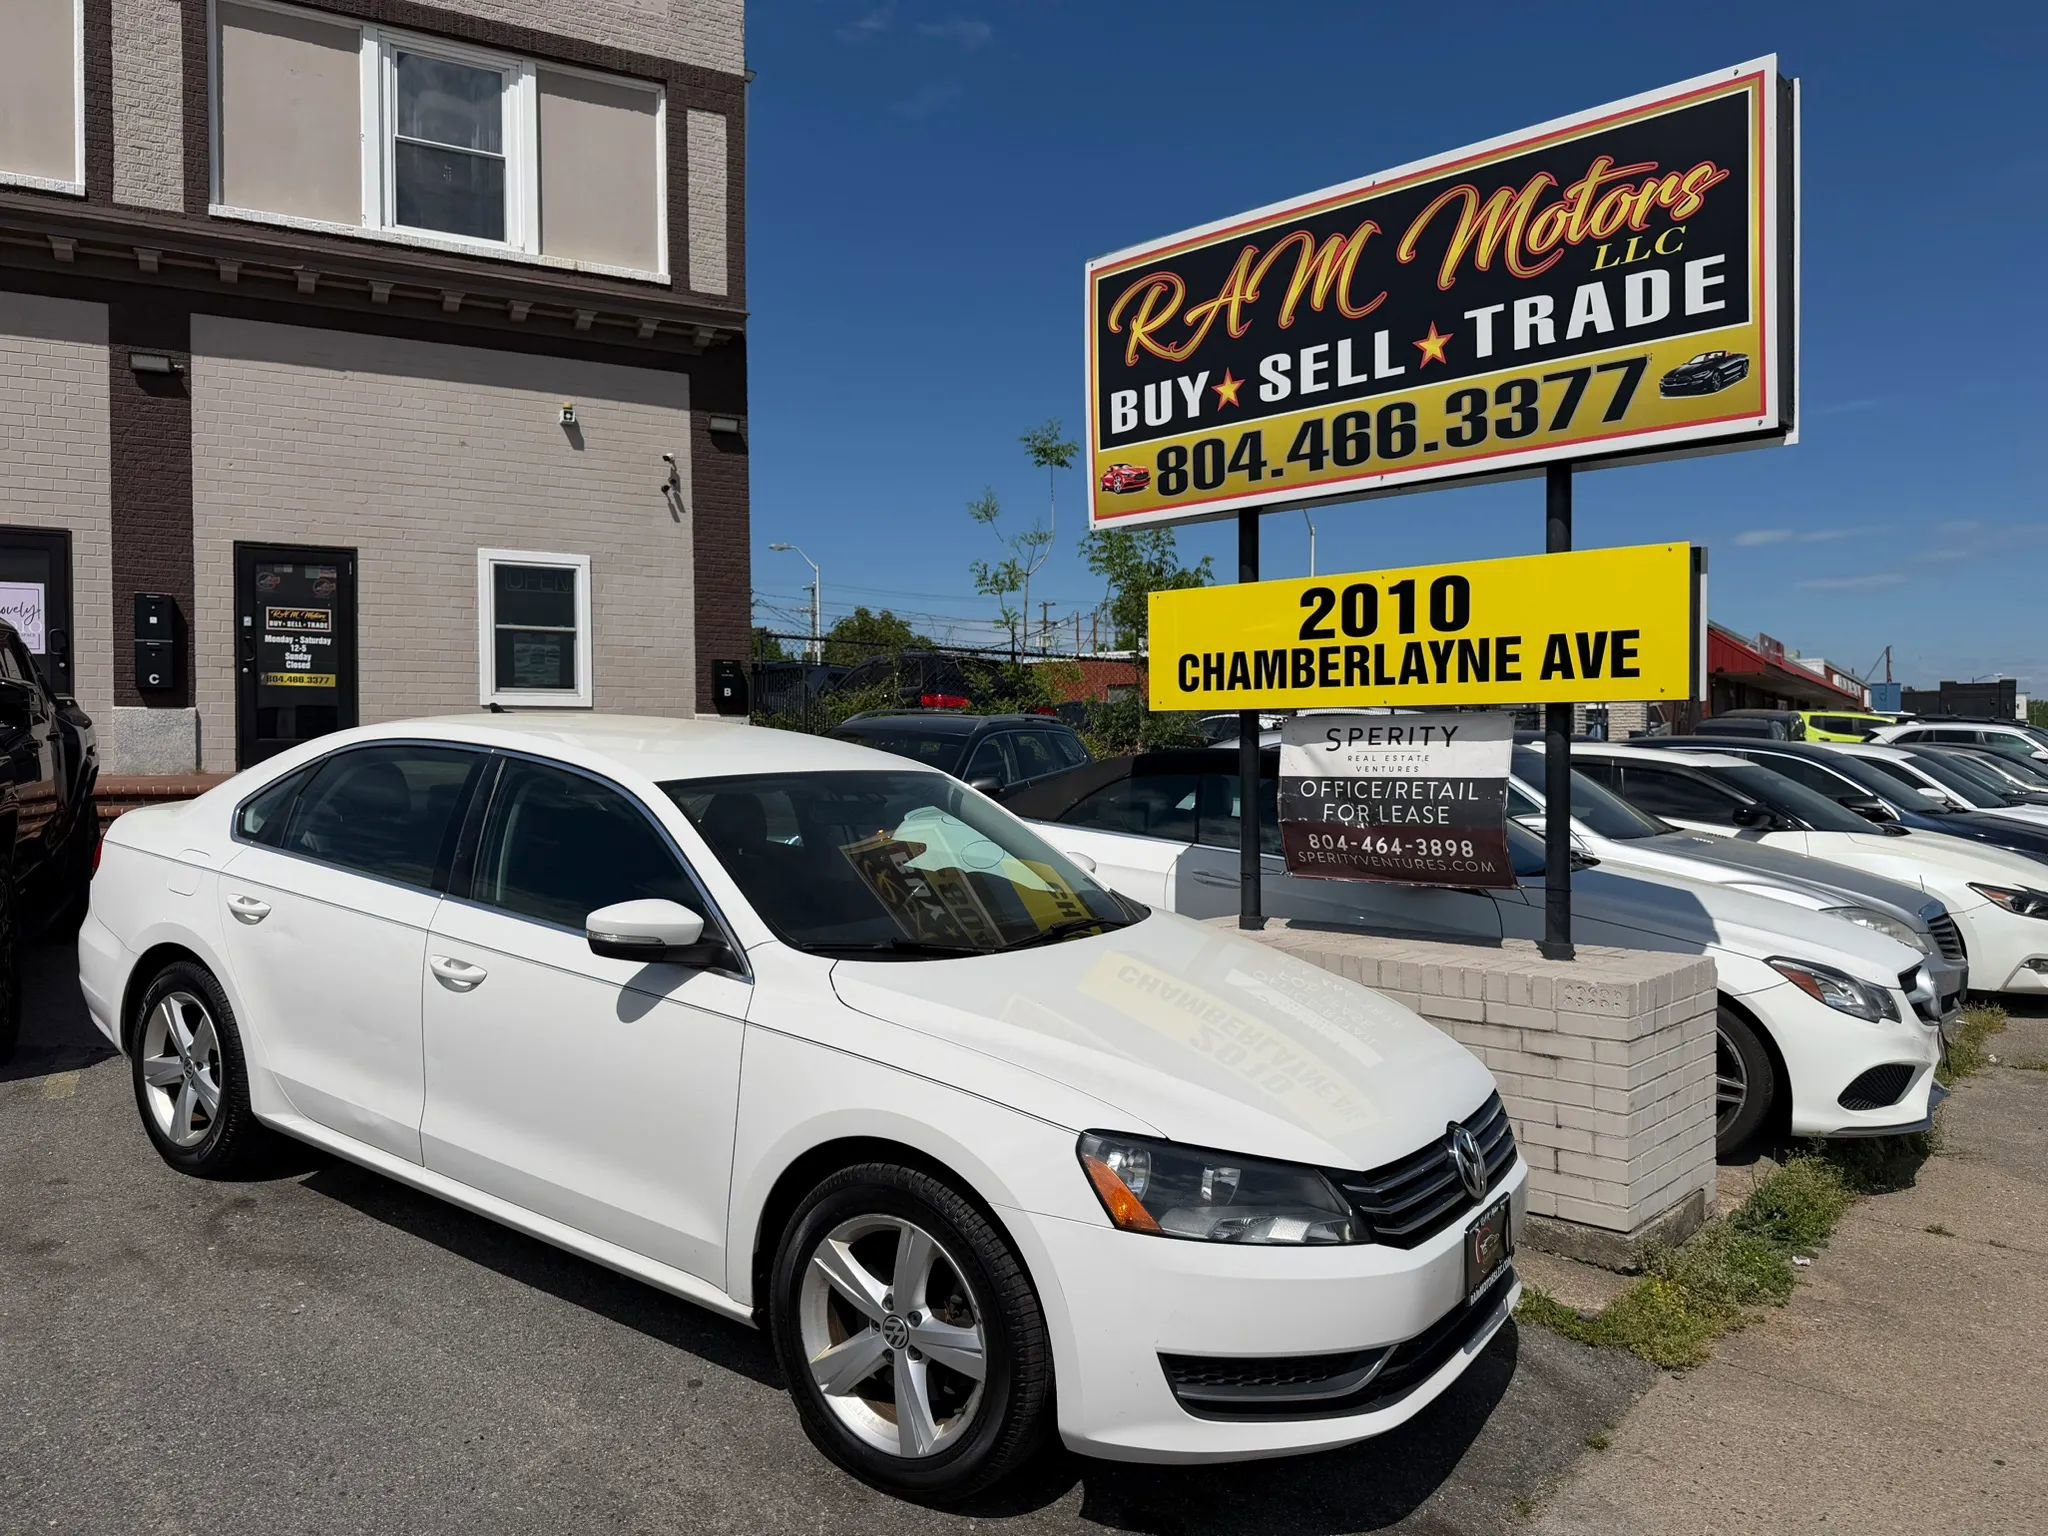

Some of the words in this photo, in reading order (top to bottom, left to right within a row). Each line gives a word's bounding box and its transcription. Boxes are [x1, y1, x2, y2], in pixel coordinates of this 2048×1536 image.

[1590, 226, 1686, 271] LLC
[1108, 220, 1387, 367] RAM
[1396, 155, 1730, 290] Motors
[1111, 370, 1210, 434] BUY
[1259, 329, 1405, 402] SELL
[1464, 254, 1726, 358] TRADE
[1156, 356, 1649, 496] 804.466.3377
[0, 601, 41, 625] ovely
[1299, 575, 1470, 640] 2010
[264, 634, 294, 644] Monday
[300, 636, 332, 646] Saturday
[290, 644, 307, 652] 12-5
[285, 652, 312, 661] Sunday
[286, 661, 311, 669] Closed
[1178, 636, 1522, 692] CHAMBERLAYNE
[1540, 629, 1640, 680] AVE
[148, 673, 160, 684] C
[723, 687, 732, 697] B
[1326, 726, 1459, 752] SPERITY
[1300, 780, 1479, 800] OFFICE/RETAIL
[1323, 803, 1370, 822] FOR
[1379, 804, 1450, 825] LEASE
[1308, 833, 1474, 858] 804-464-3898
[1298, 851, 1496, 873] SPERITYVENTURES.COM
